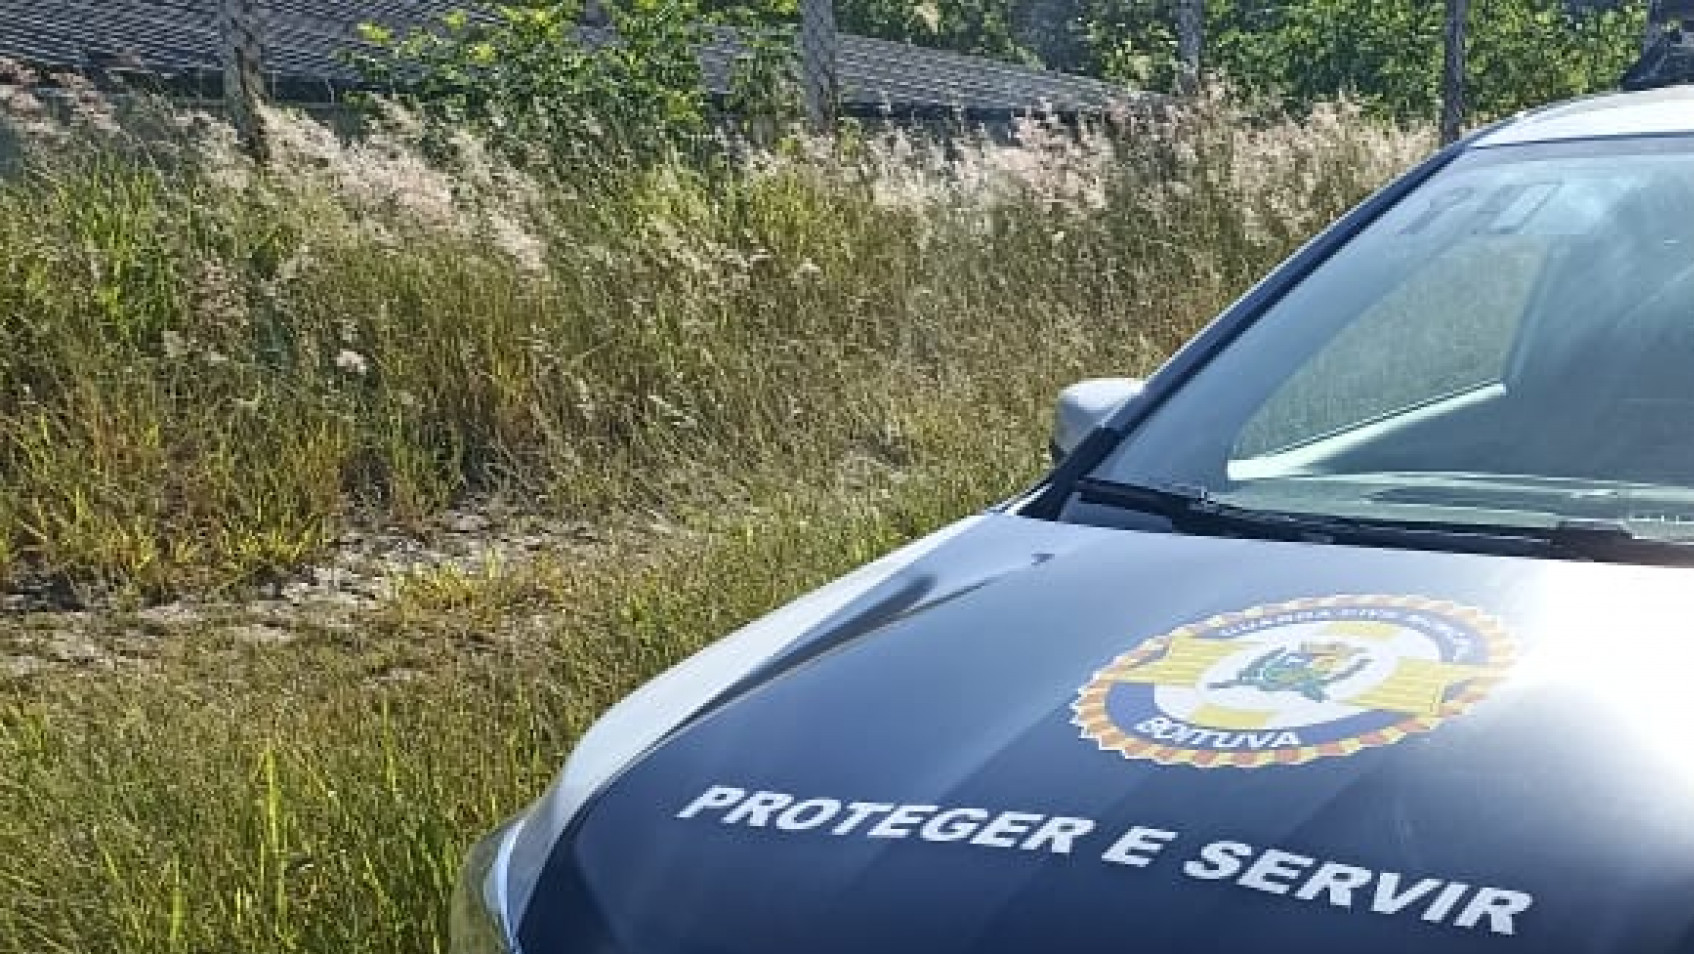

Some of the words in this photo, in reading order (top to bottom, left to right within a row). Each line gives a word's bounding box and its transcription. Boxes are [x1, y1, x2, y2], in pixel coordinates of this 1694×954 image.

[1134, 716, 1301, 748] BOITUVA
[676, 784, 1095, 854] PROTEGER
[1101, 825, 1179, 868] E
[1183, 840, 1534, 935] SERVIR
